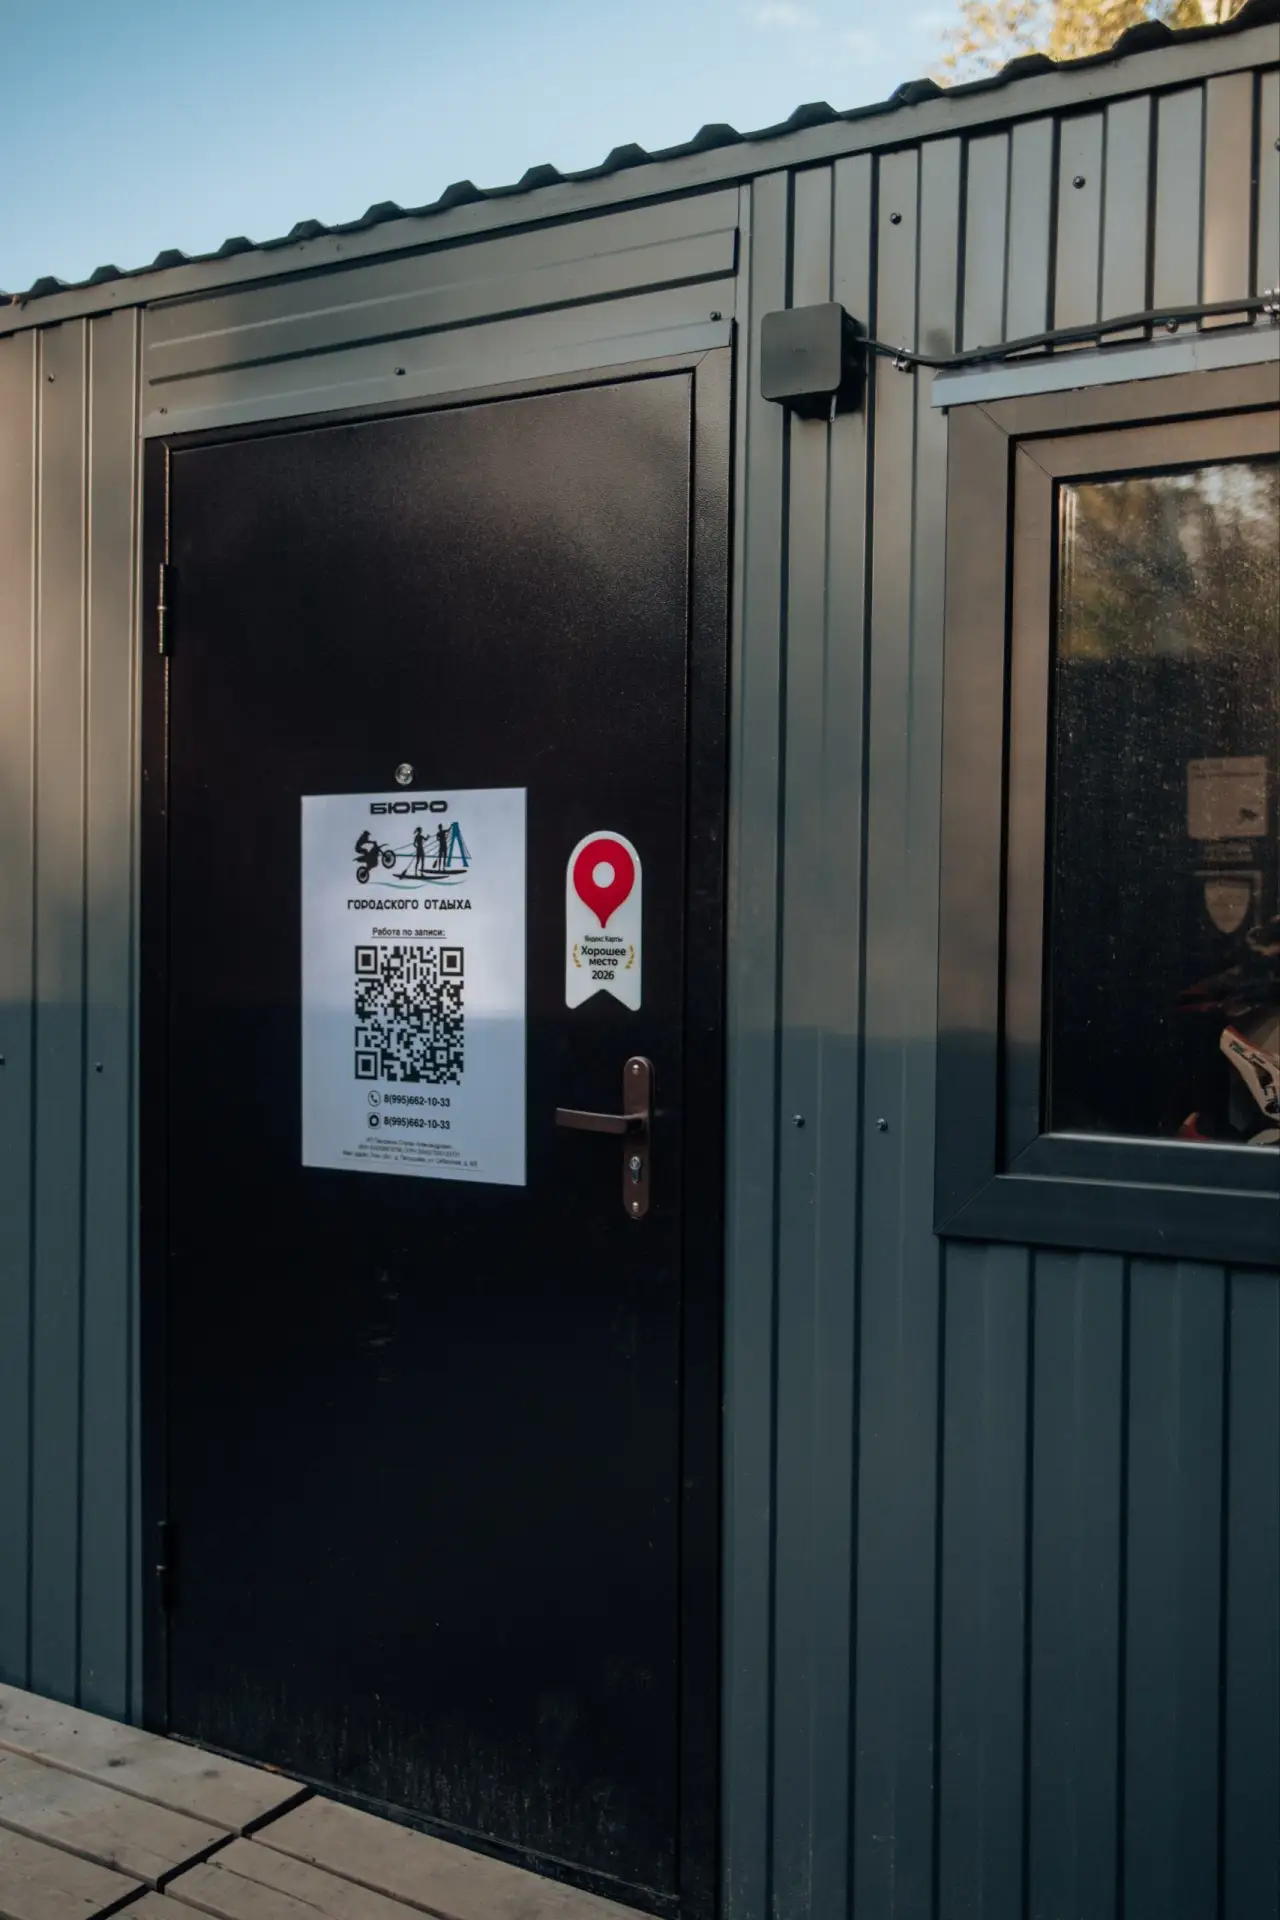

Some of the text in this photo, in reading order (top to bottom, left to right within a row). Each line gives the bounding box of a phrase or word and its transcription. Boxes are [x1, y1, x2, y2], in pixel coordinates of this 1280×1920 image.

[369, 800, 448, 814] БЮРО
[347, 899, 472, 911] ГОРОДСКОГО ОТДЫХА
[372, 927, 446, 937] Работа по записи:
[581, 945, 627, 957] Хорошее
[589, 958, 619, 966] место
[591, 970, 615, 980] 2026
[383, 1094, 451, 1107] 8(995)662-10-33
[383, 1116, 451, 1130] 8(995)662-10-33
